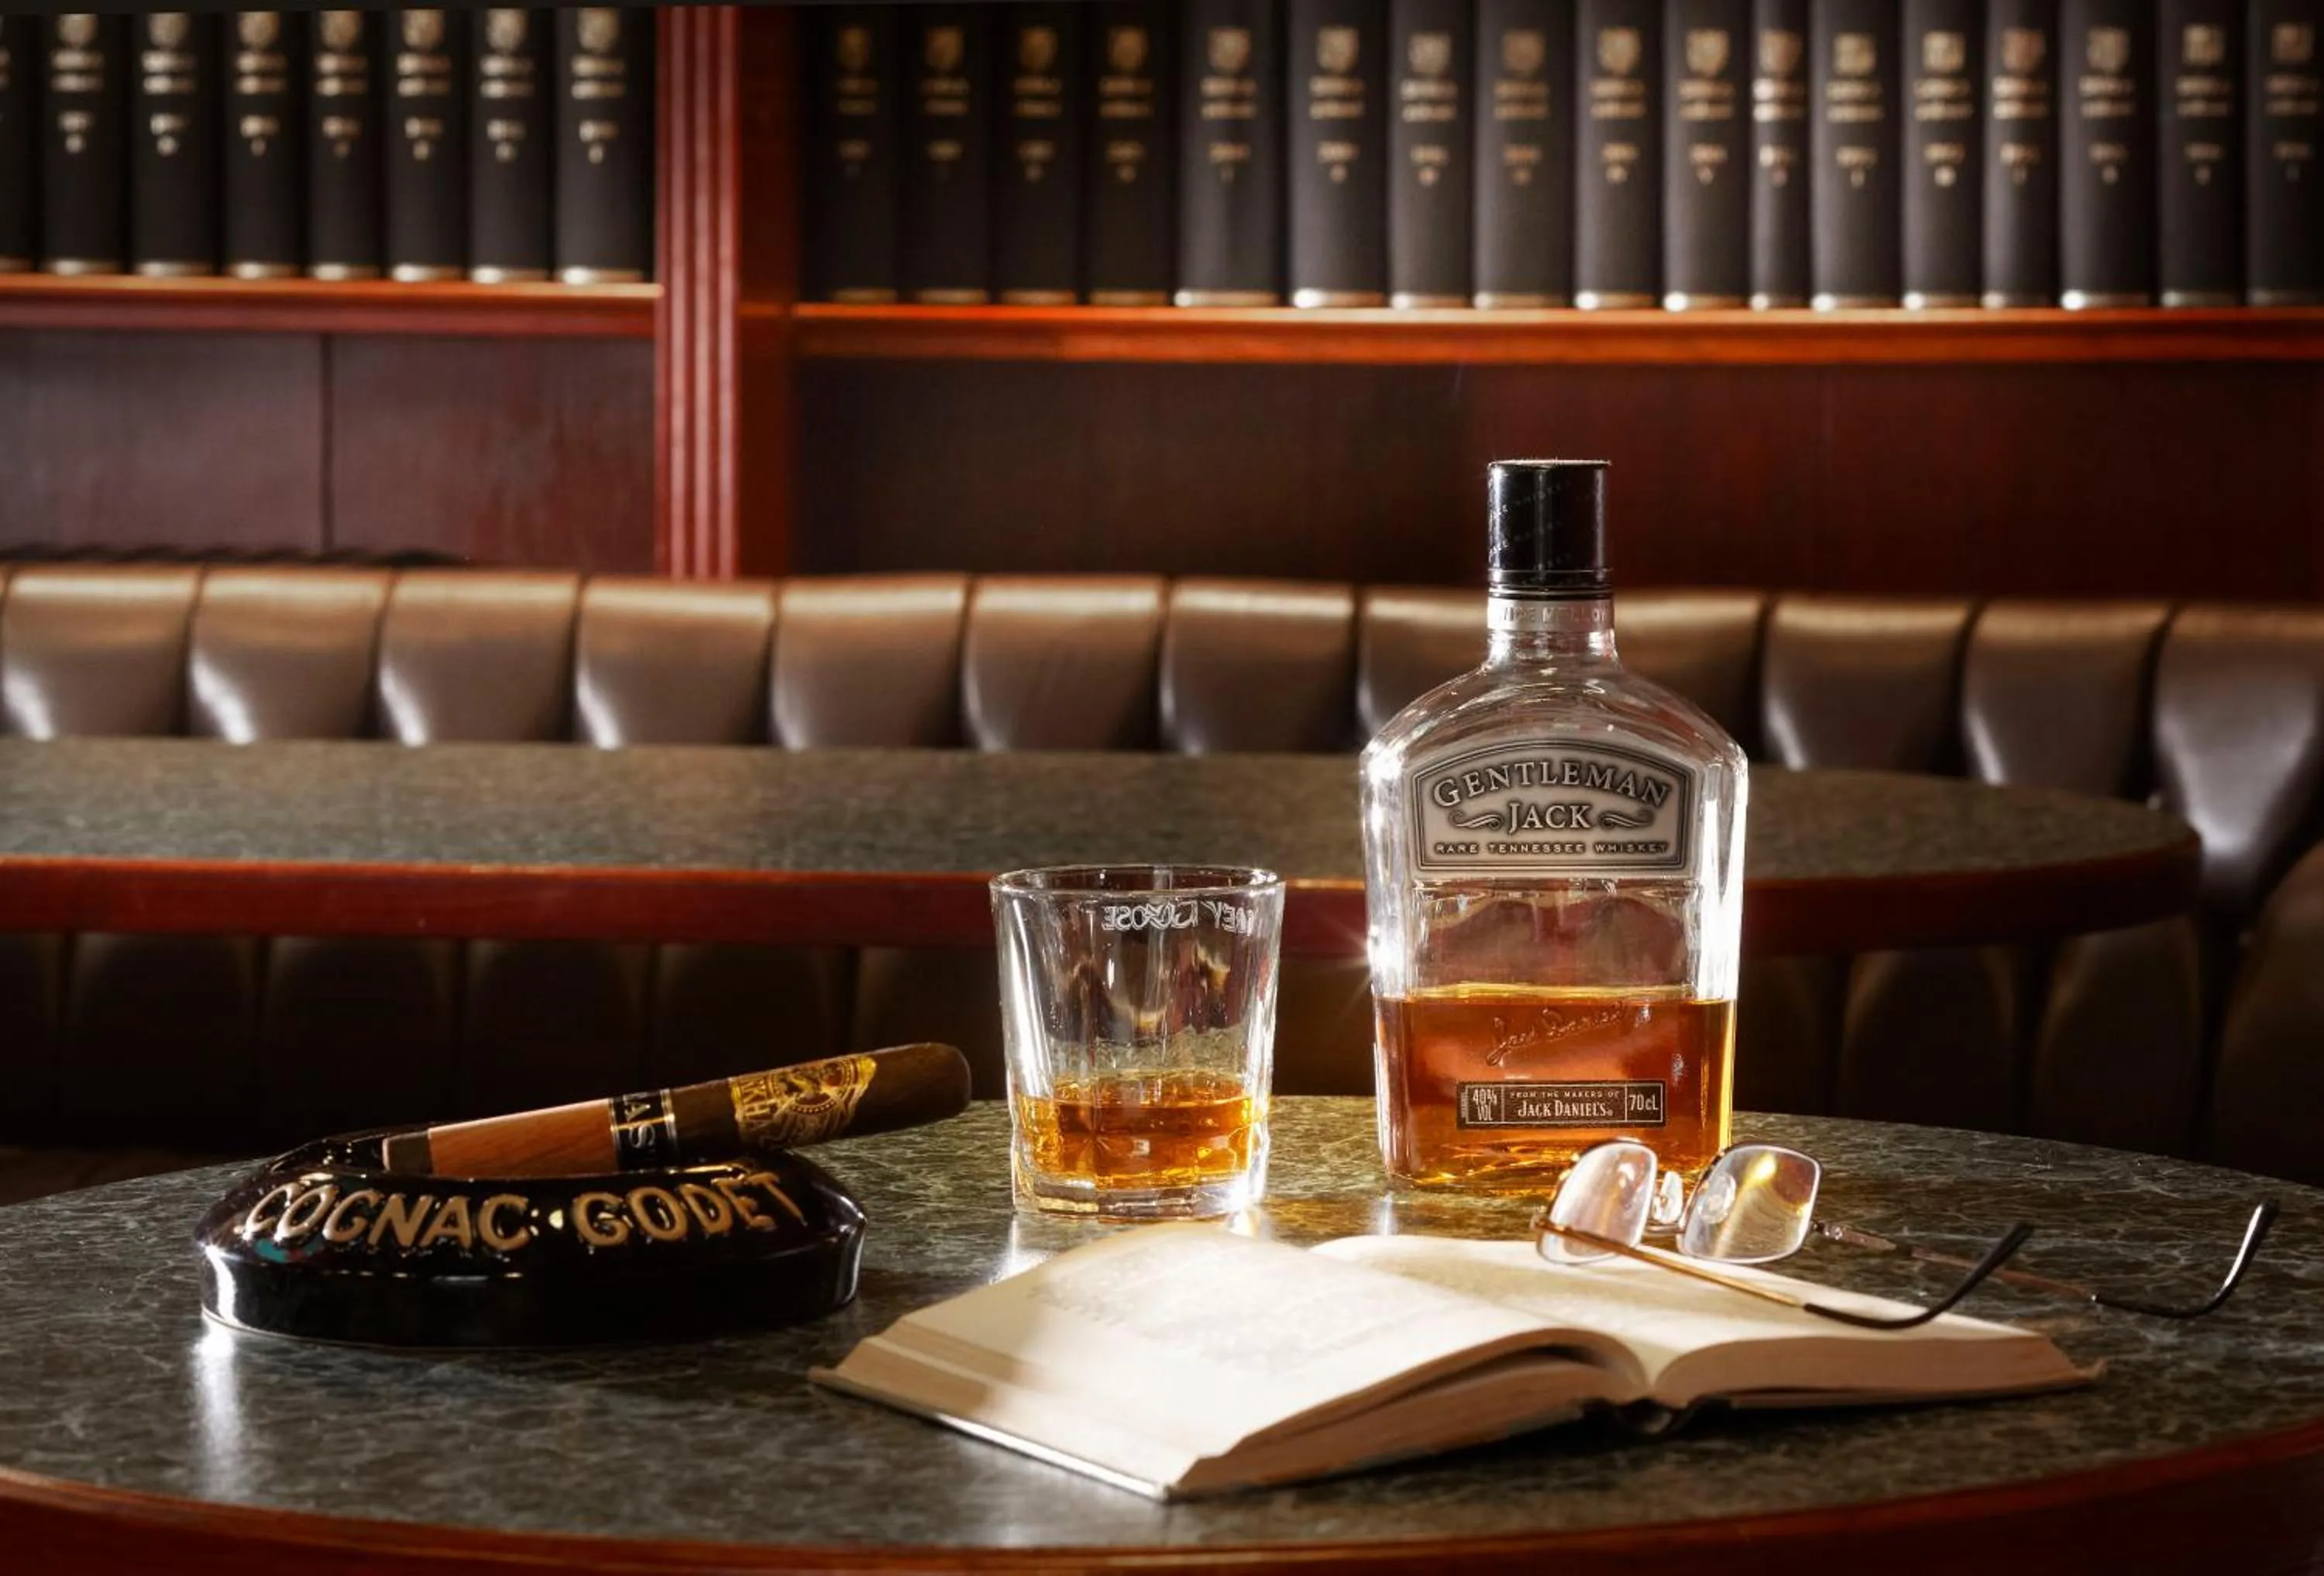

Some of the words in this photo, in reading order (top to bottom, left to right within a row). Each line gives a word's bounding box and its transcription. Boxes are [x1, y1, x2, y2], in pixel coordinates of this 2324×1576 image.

[1433, 762, 1669, 807] GENTLEMAN
[1508, 804, 1592, 834] JACK
[1436, 843, 1477, 854] RARE
[1488, 843, 1585, 854] TENNESSEE
[1594, 843, 1667, 854] WHISKEY
[241, 1182, 530, 1251] COGNAC
[571, 1171, 808, 1247] GODET
